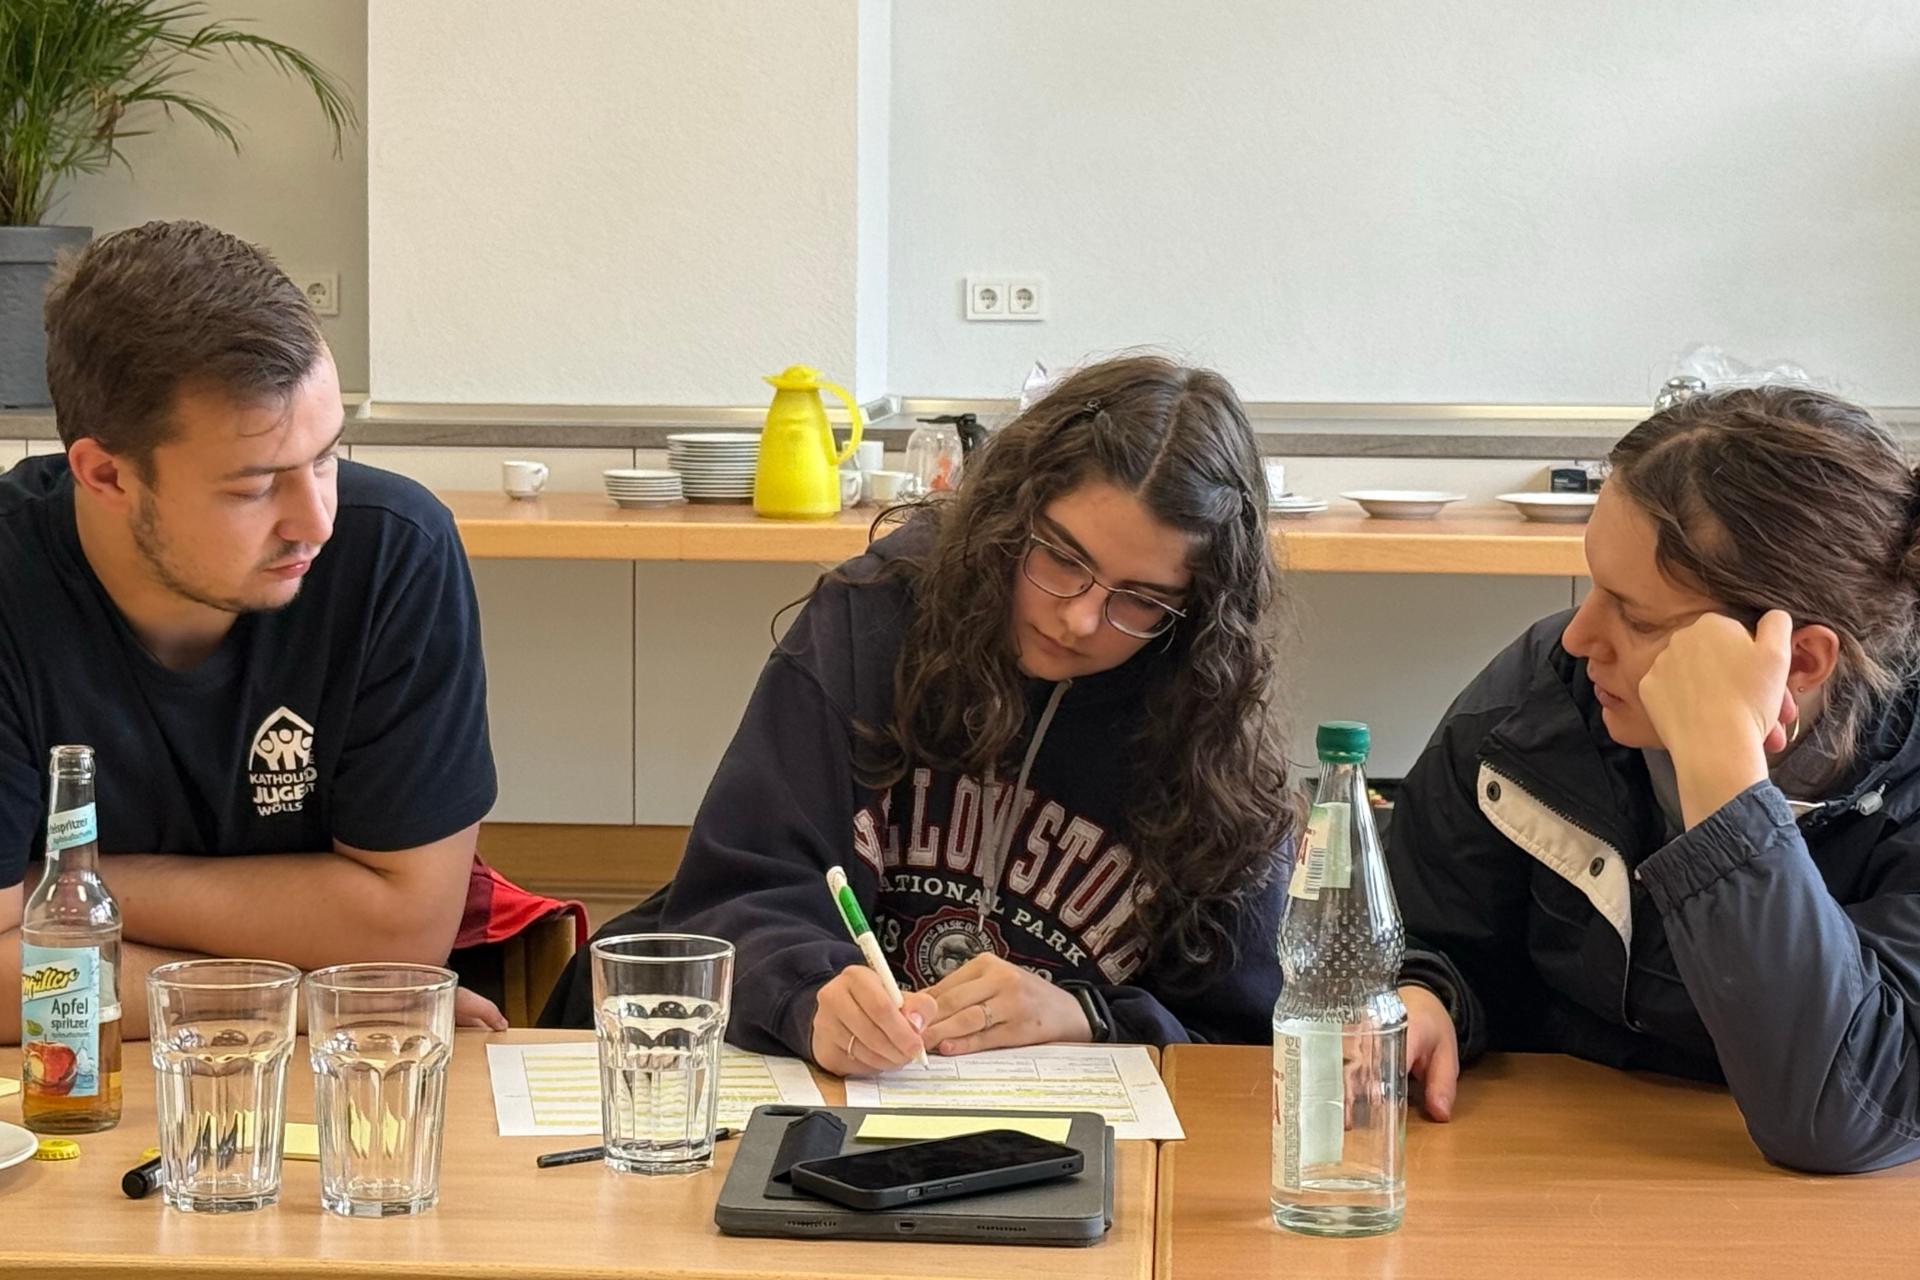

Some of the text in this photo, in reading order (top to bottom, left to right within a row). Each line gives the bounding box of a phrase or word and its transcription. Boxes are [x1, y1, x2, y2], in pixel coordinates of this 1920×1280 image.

[874, 875, 1087, 967] ATIONAL PARK
[51, 998, 88, 1018] Apfel
[51, 1018, 88, 1031] spritzer
